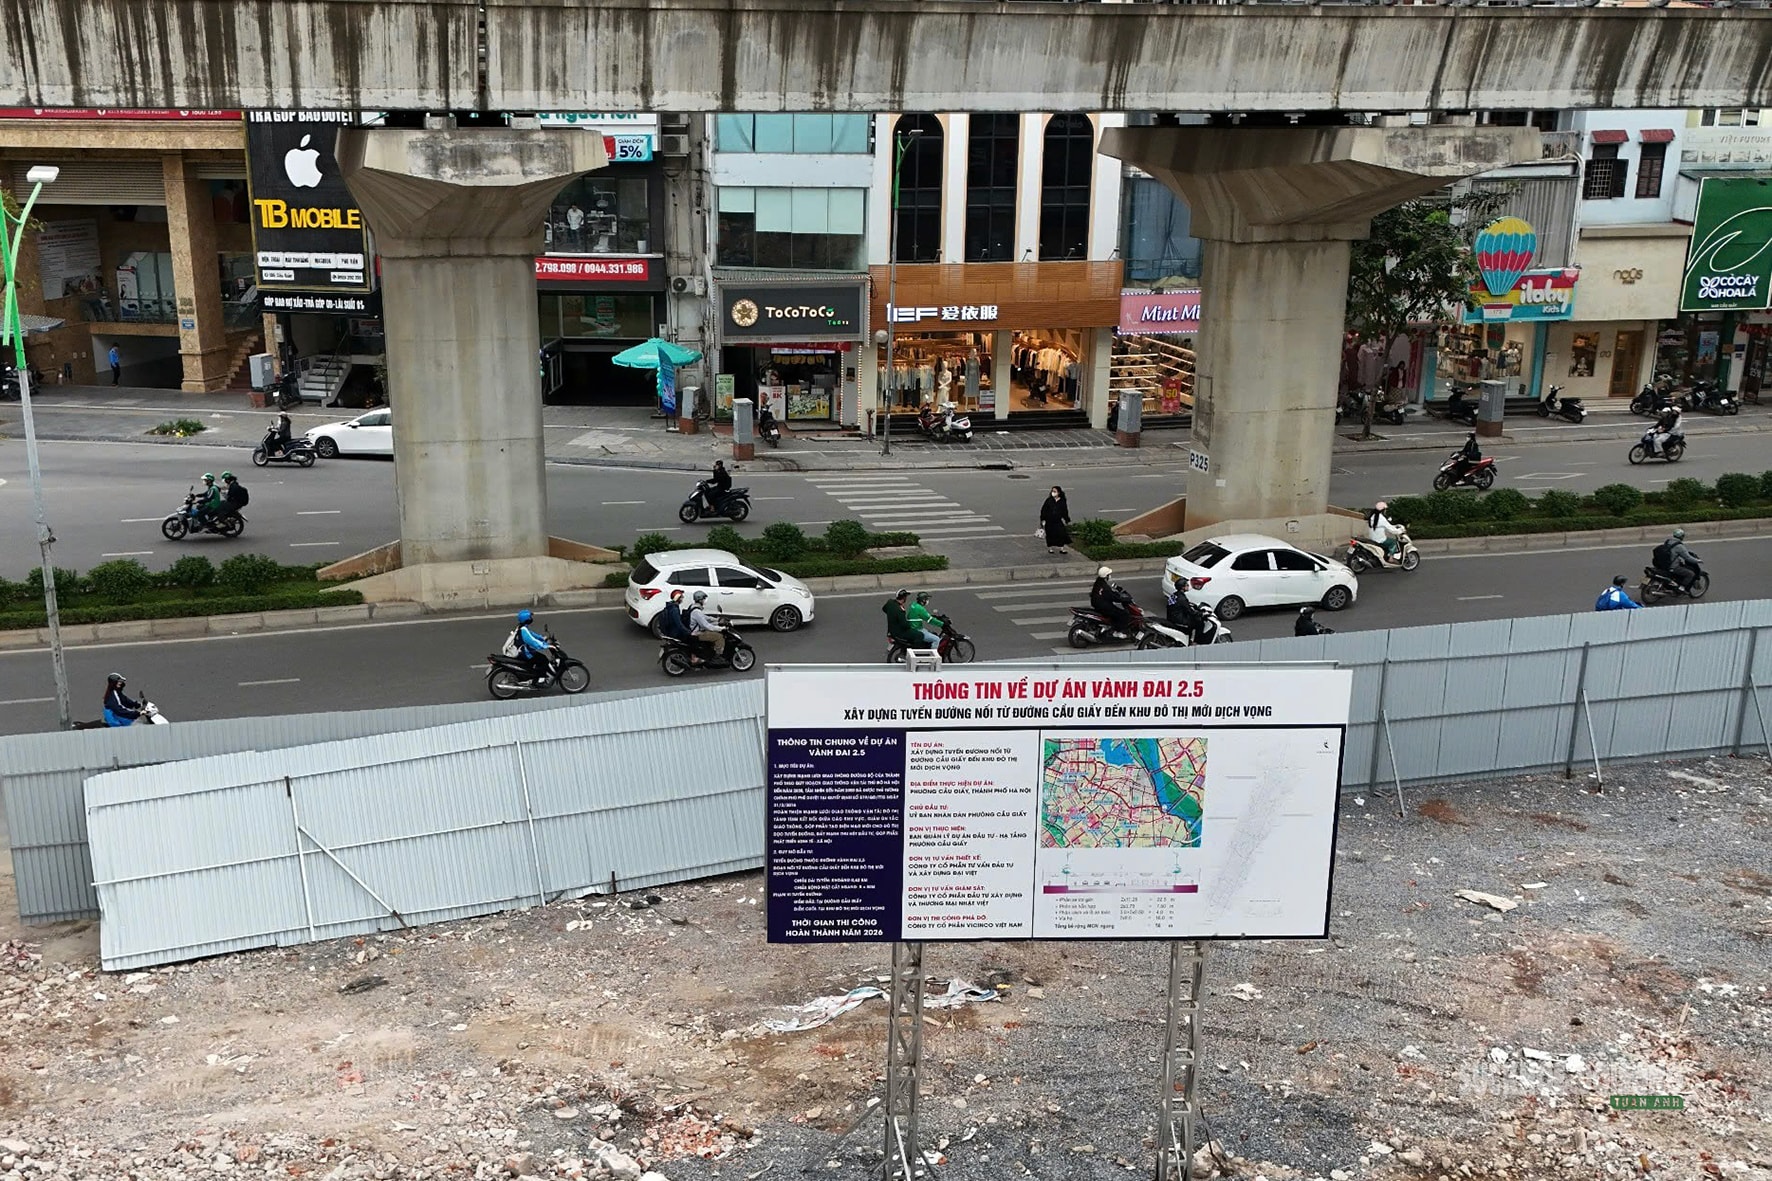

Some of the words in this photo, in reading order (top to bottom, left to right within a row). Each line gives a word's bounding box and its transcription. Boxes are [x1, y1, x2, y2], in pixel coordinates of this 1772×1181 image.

[620, 146, 642, 158] 5%
[254, 199, 288, 228] TB
[291, 208, 361, 229] MOBILE
[942, 305, 998, 320] 爱依服
[1142, 305, 1178, 320] Mint
[1543, 305, 1559, 313] Kids
[1166, 389, 1177, 398] 50
[1190, 453, 1208, 471] P325
[915, 680, 968, 700] THÔNG
[976, 682, 1002, 699] TIN
[1008, 677, 1027, 698] VỀ
[1034, 680, 1058, 702] DỰ
[1063, 678, 1086, 698] ÁN
[1092, 678, 1138, 698] VÀNH
[1144, 681, 1172, 697] ĐAI
[1178, 681, 1203, 697] 2.5
[844, 707, 864, 720] XÂY
[868, 708, 897, 722] DỰNG
[902, 705, 932, 719] TUYẾN
[935, 706, 971, 719] ĐƯỜNG
[975, 705, 993, 718] NỐI
[997, 706, 1010, 718] TỪ
[1013, 705, 1049, 718] ĐƯỜNG
[1052, 704, 1074, 718] CẦU
[1077, 703, 1101, 718] GIẤY
[1105, 703, 1126, 717] ĐẾN
[1129, 707, 1151, 717] KHU
[1154, 704, 1168, 717] ĐÔ
[1173, 706, 1188, 719] THỊ
[1192, 704, 1212, 717] MỚI
[1215, 706, 1240, 719] DỊCH
[1244, 706, 1272, 719] VỌNG
[858, 736, 868, 745] VỀ
[871, 738, 883, 746] DỰ
[809, 748, 833, 756] VÀNH
